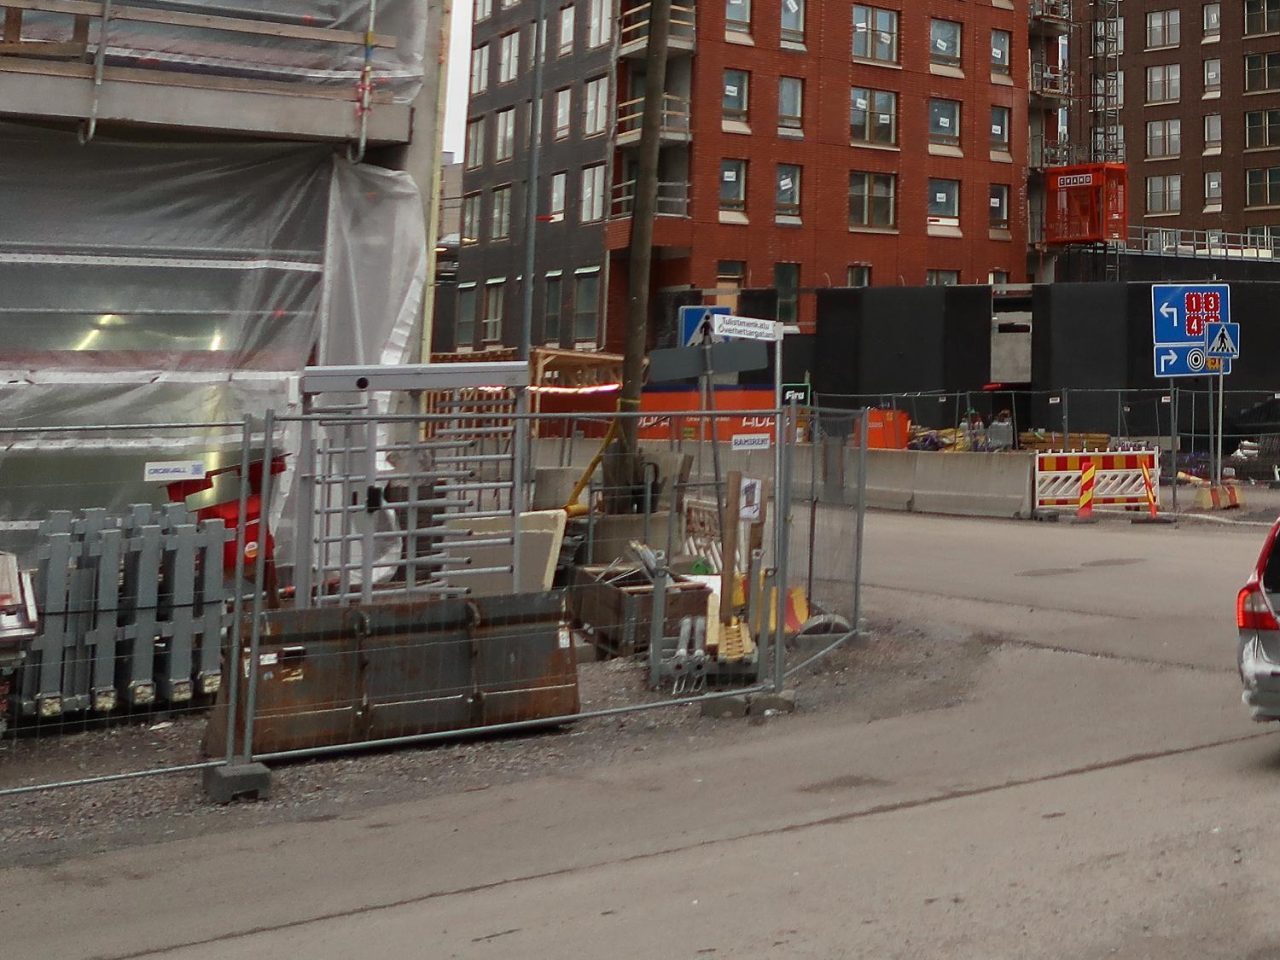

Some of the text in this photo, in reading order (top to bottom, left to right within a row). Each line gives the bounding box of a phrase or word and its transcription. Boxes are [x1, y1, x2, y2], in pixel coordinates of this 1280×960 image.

[1191, 296, 1215, 310] 1 3
[1191, 318, 1198, 332] 4
[785, 390, 805, 401] Fira
